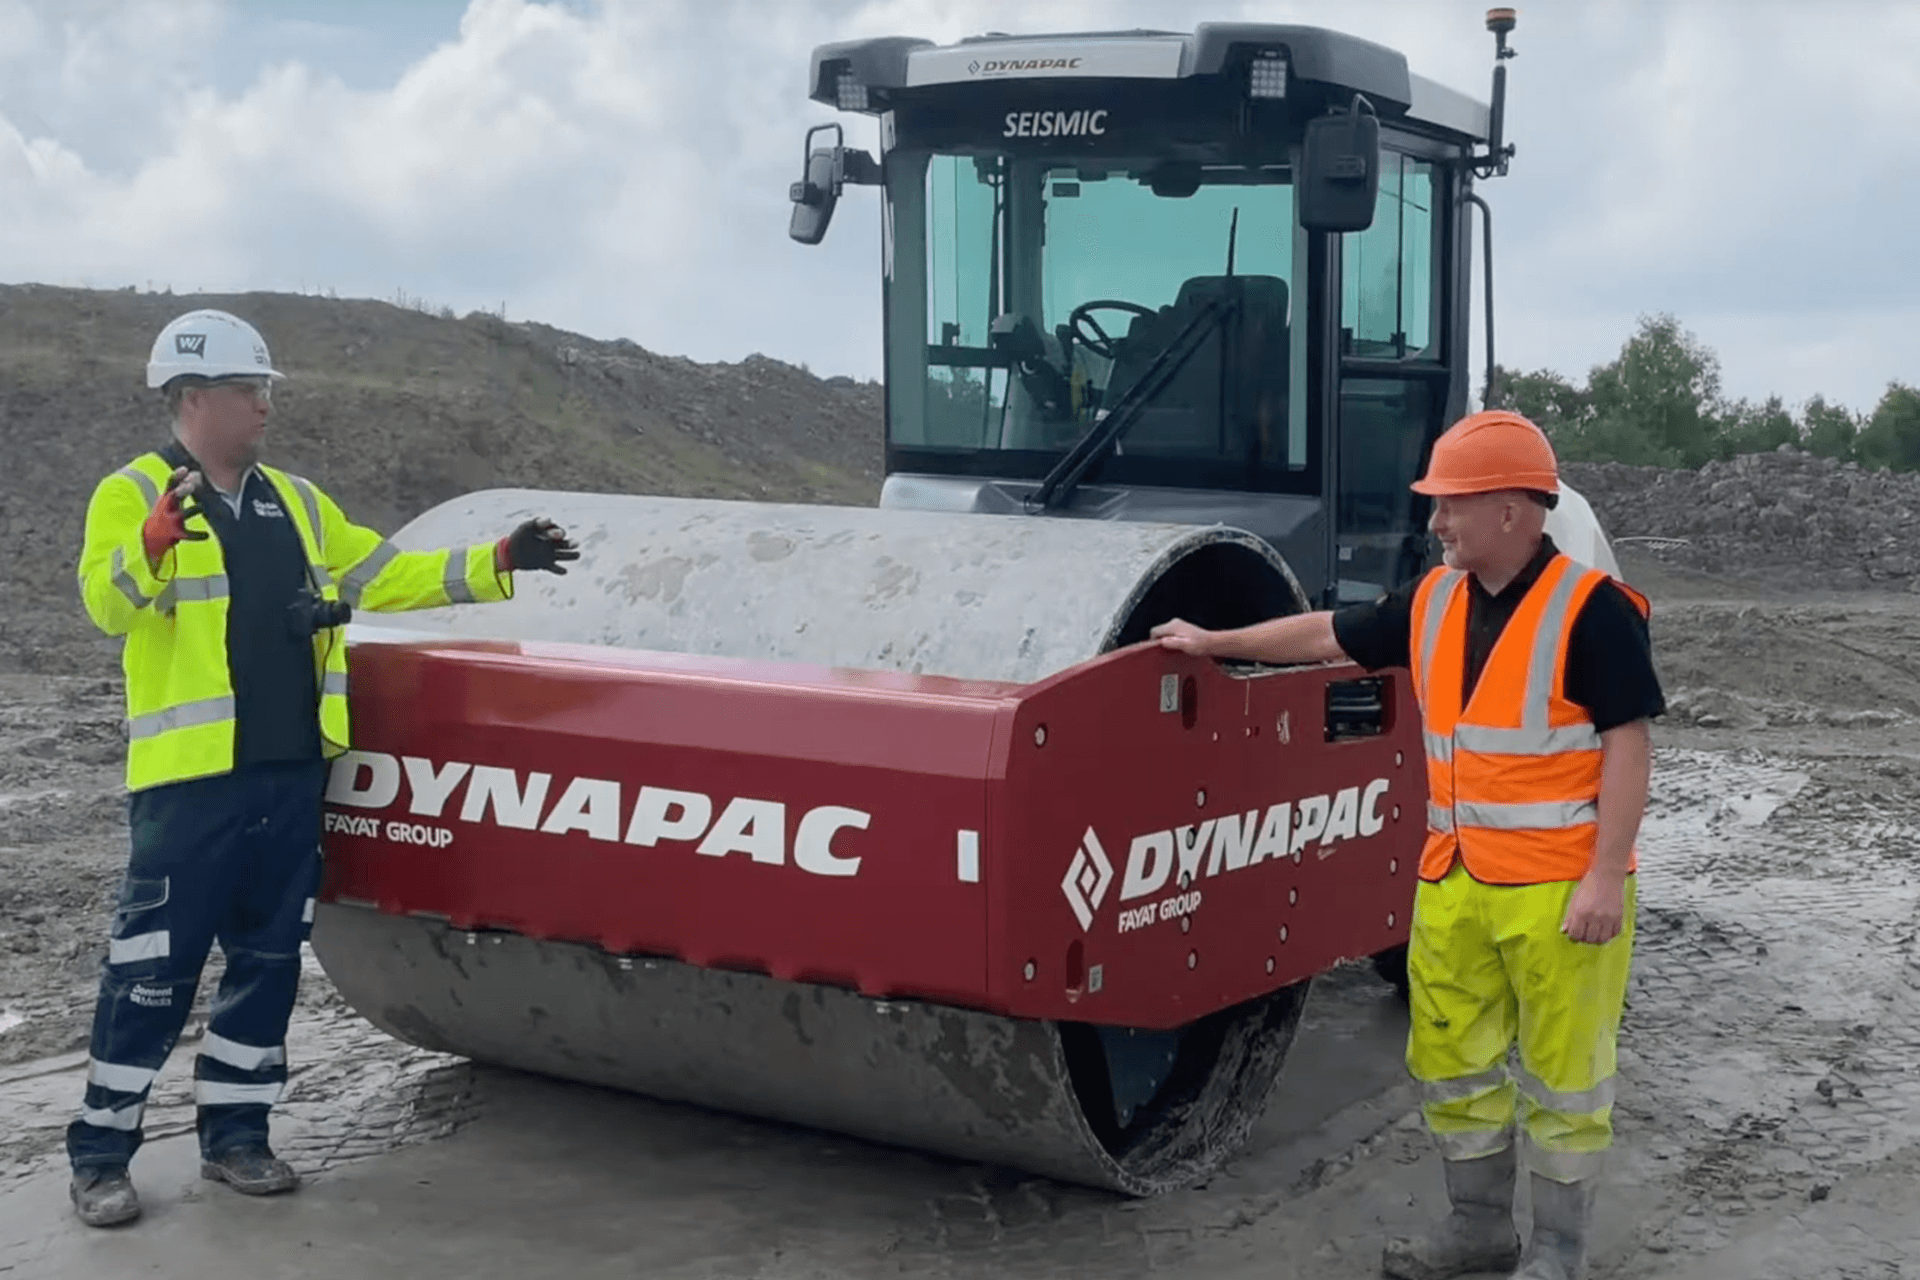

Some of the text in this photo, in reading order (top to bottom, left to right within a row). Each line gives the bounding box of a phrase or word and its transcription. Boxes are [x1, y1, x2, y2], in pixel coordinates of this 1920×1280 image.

[982, 57, 1082, 71] DYNAPAC
[1003, 110, 1108, 137] SEISMIC
[324, 813, 453, 848] FAYAT GROUP
[325, 750, 870, 876] DYNAPAC
[1119, 778, 1389, 901] DYNAPAC
[1118, 891, 1201, 933] FAYAT GROUP
